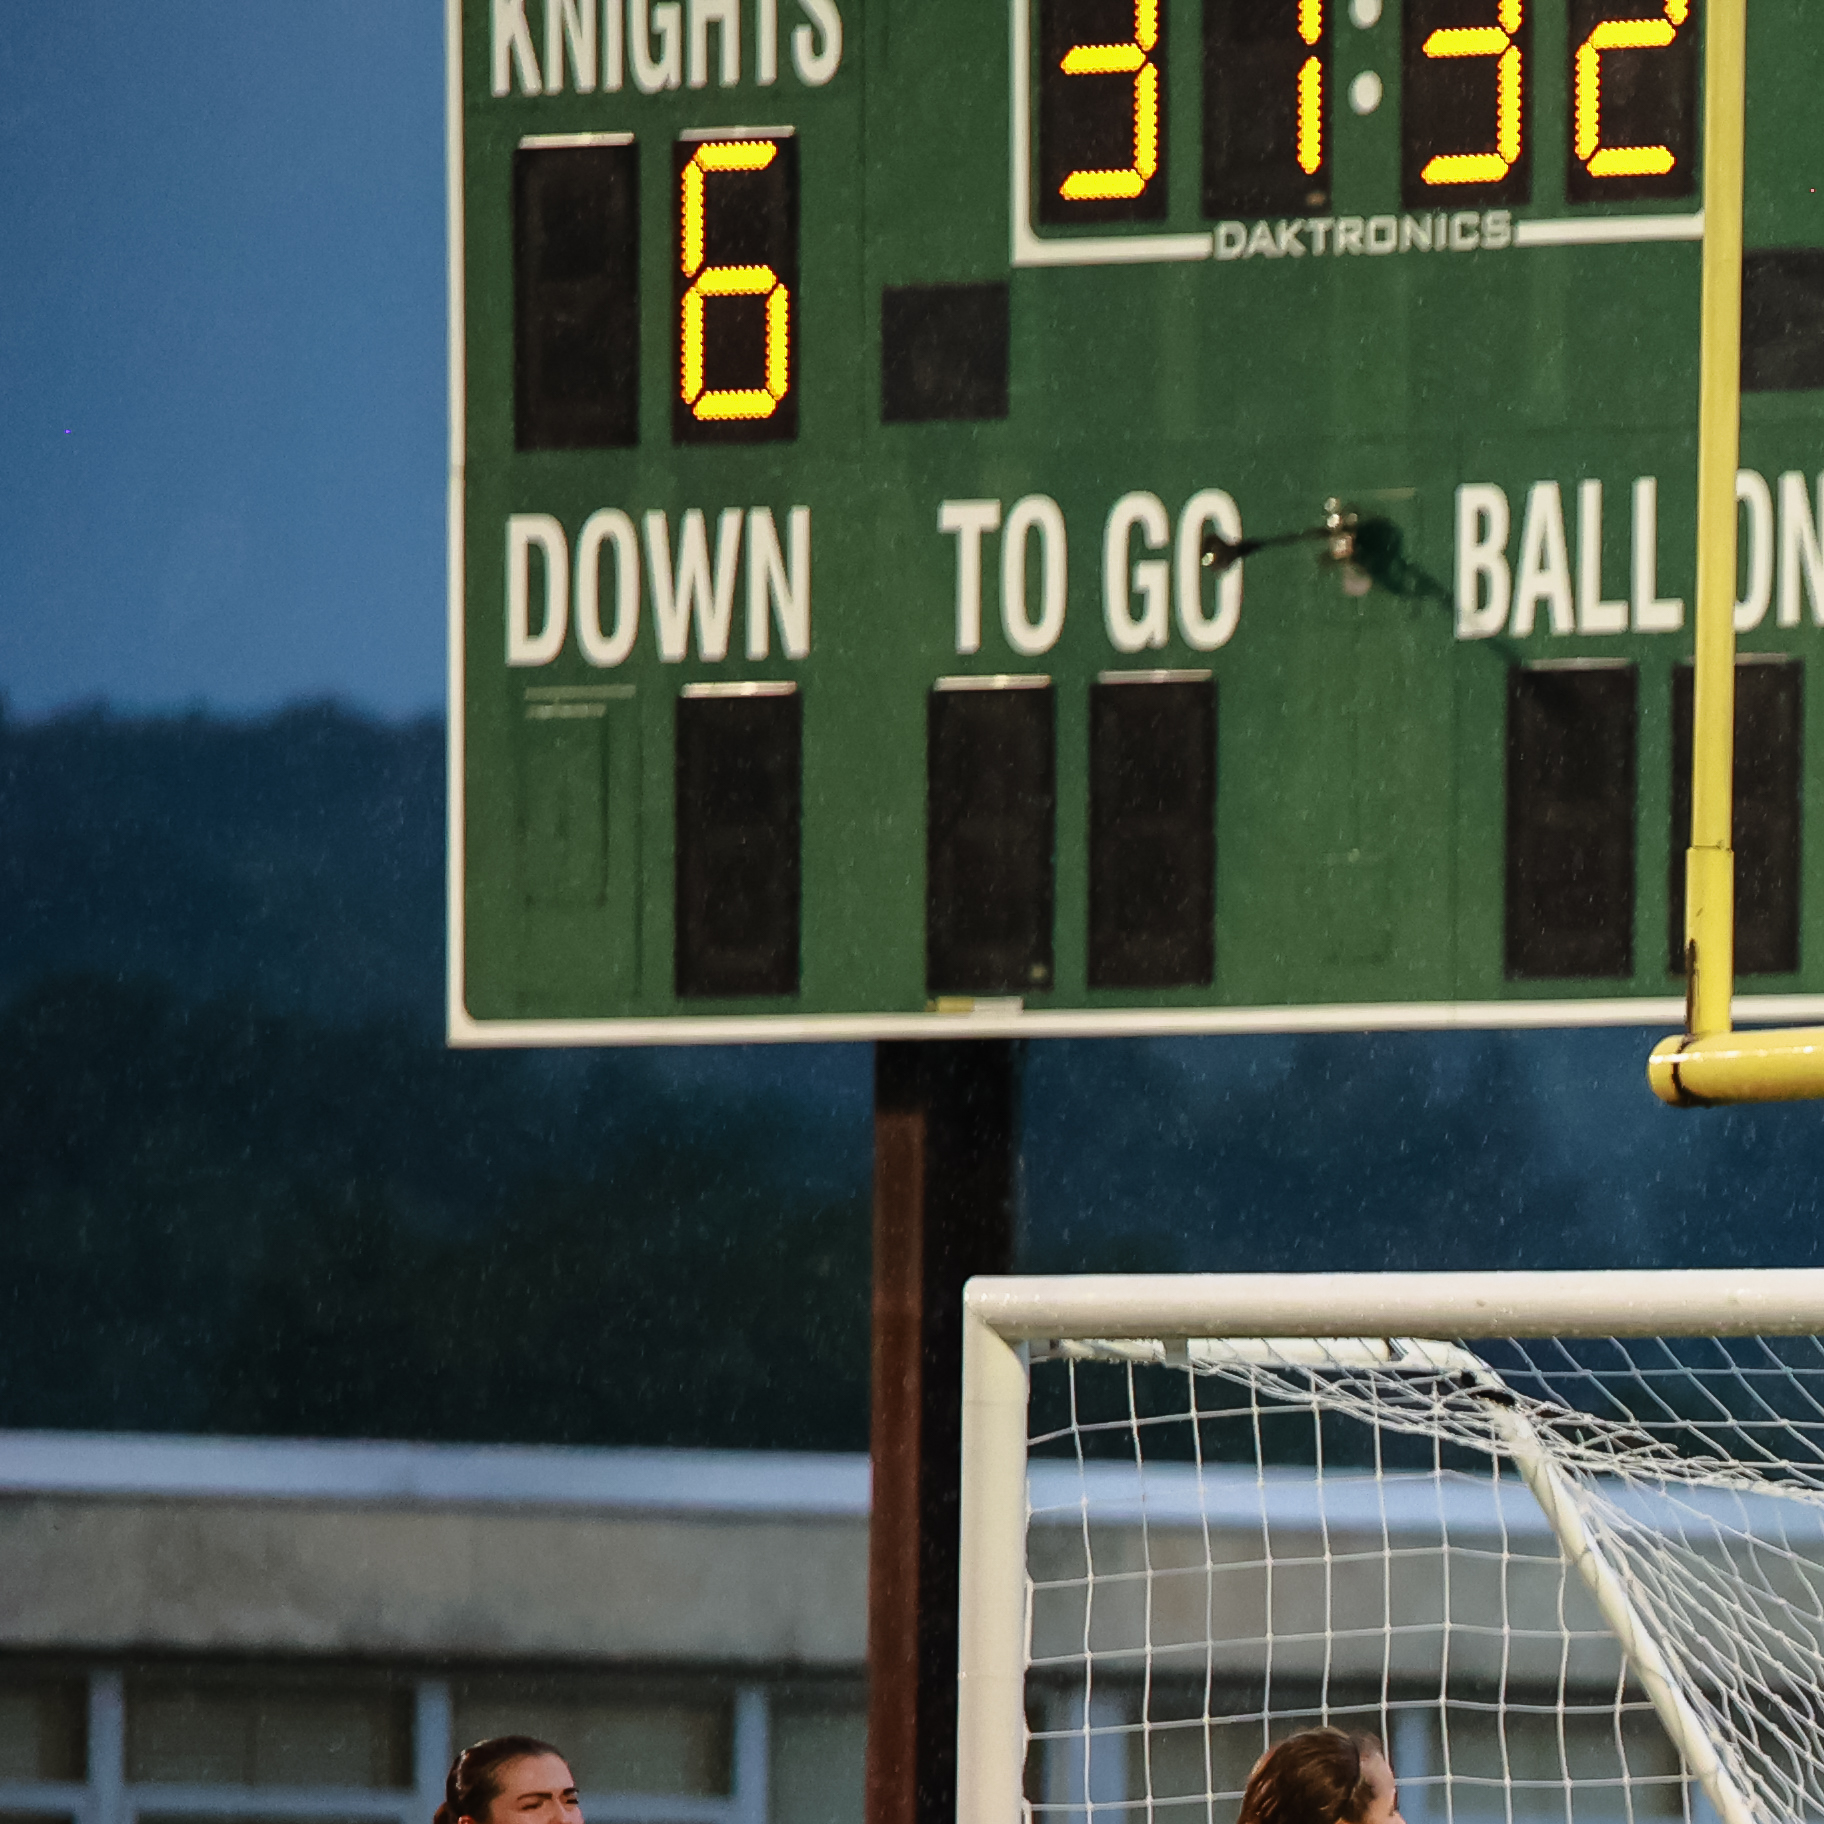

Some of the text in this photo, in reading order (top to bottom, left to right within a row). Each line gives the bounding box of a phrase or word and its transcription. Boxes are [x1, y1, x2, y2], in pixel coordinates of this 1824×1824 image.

[491, 0, 843, 97] KNIGHTS
[681, 141, 789, 421] 6
[1212, 210, 1513, 260] DAKTRONICS
[505, 506, 810, 666] DOWN
[938, 489, 1243, 655] TO GO
[1455, 476, 1683, 639] BALL
